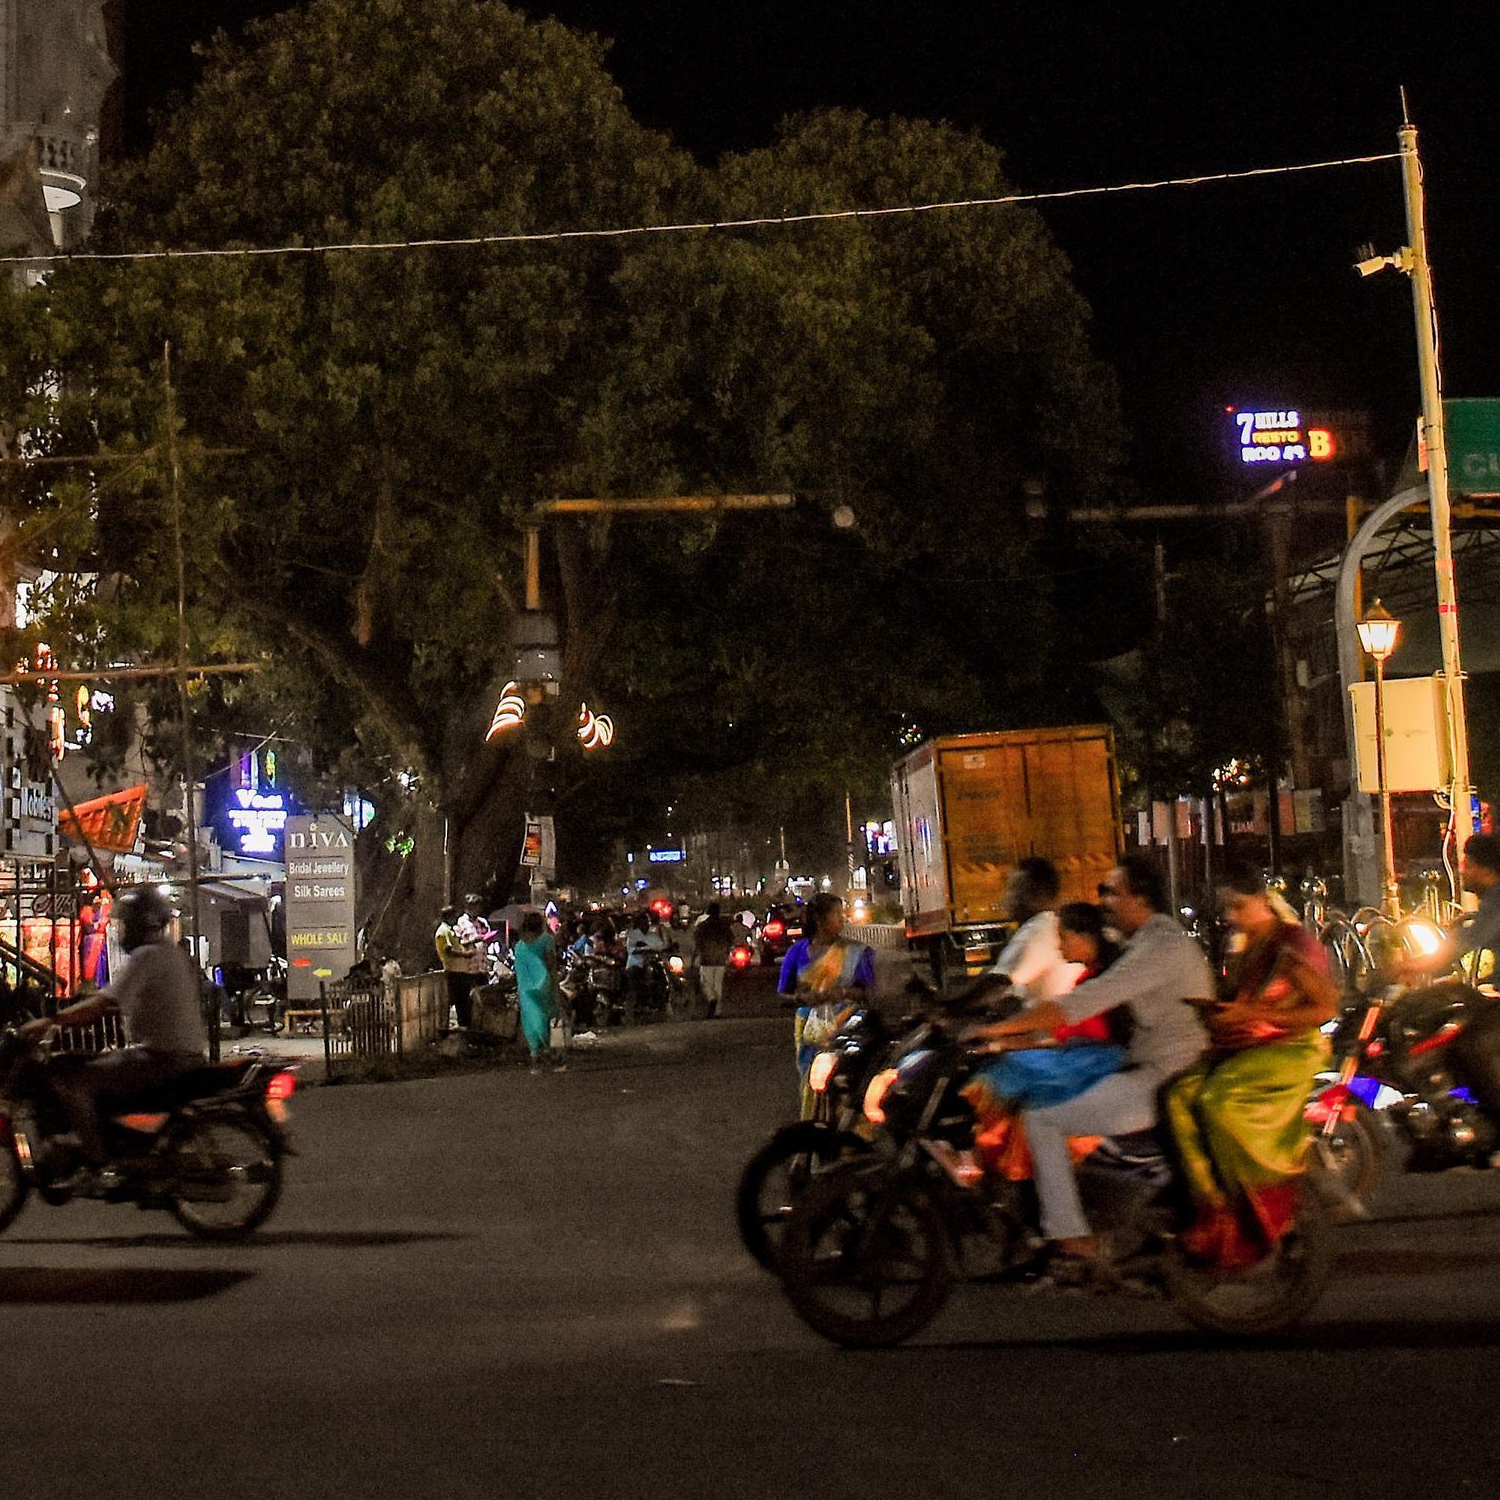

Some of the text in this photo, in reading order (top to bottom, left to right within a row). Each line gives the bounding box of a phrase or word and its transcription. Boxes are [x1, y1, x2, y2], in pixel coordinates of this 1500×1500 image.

[1236, 412, 1254, 444] 7
[289, 861, 349, 876] Bridal Jewellery
[294, 885, 345, 898] Silk Sarees
[291, 933, 325, 946] WHOLE
